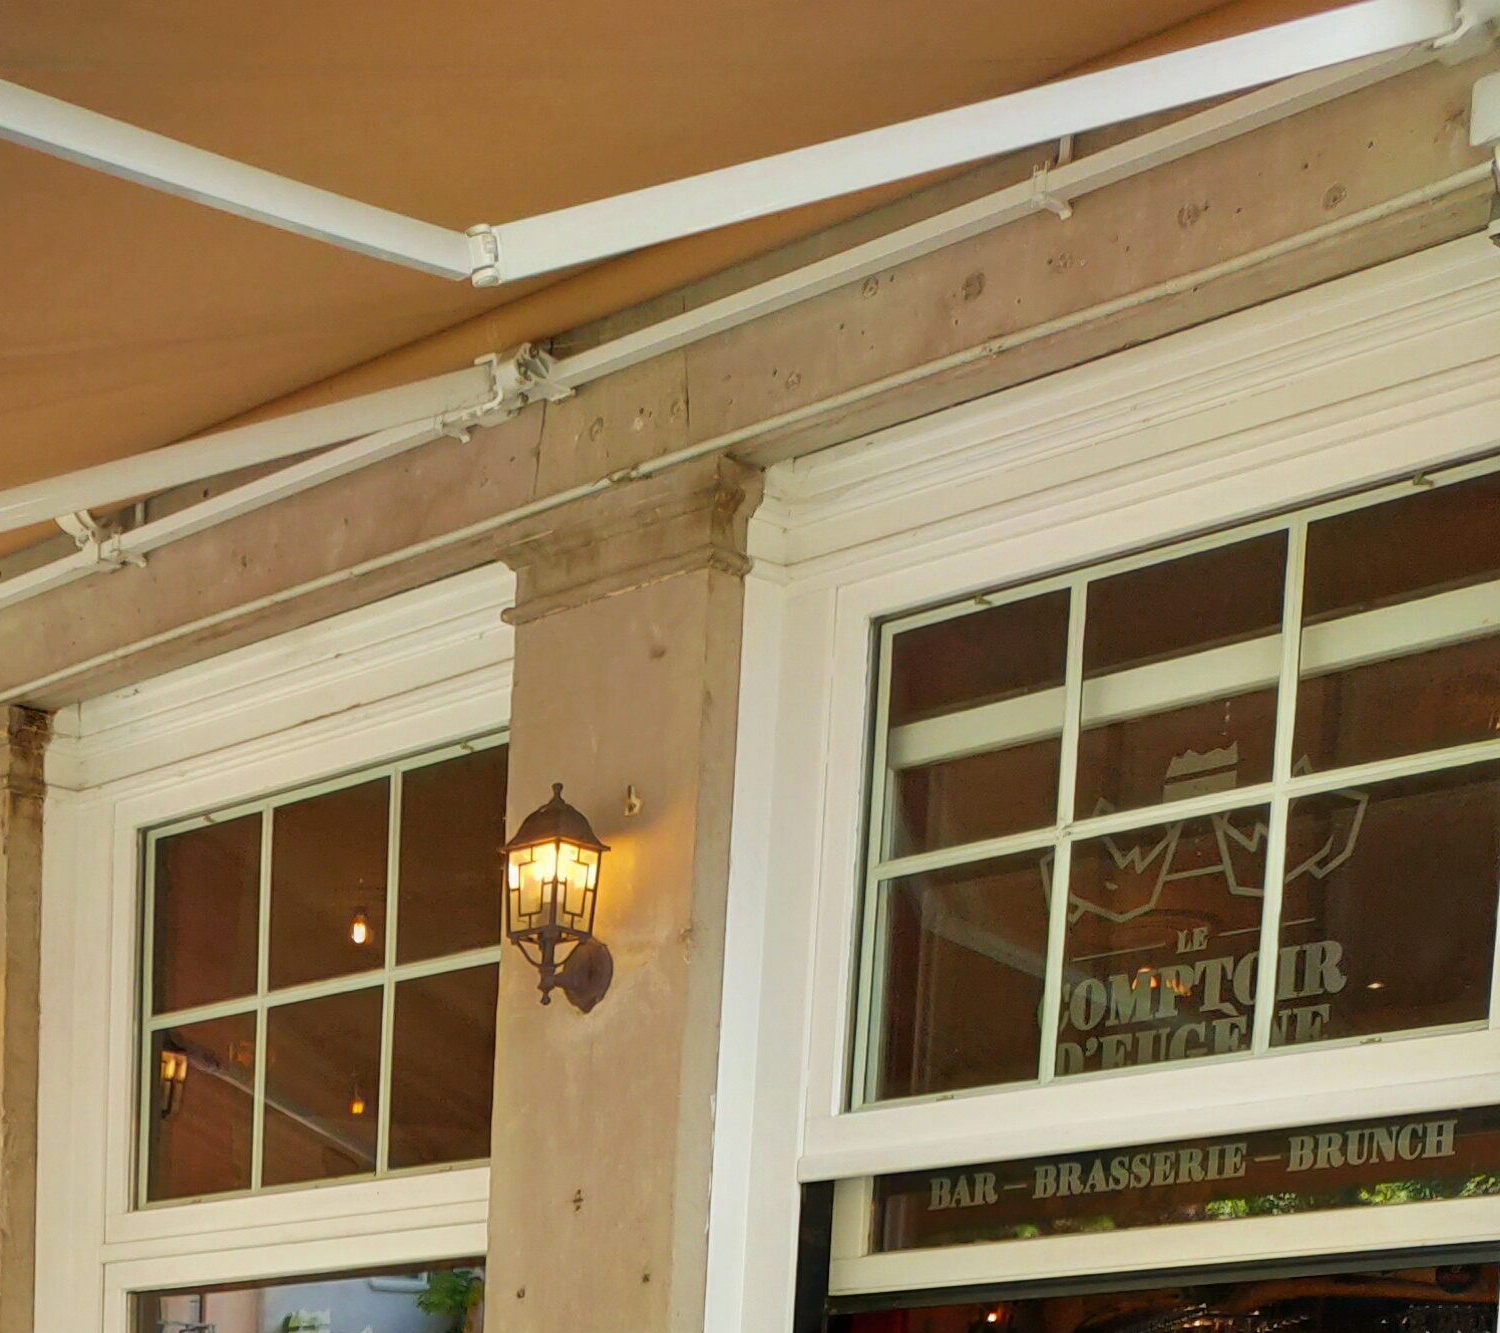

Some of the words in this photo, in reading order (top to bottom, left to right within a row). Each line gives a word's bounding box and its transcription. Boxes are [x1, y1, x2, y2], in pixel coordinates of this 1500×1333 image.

[1176, 926, 1209, 955] LE
[927, 1169, 998, 1212] BAR
[1031, 1142, 1248, 1200] BRASSERIE
[1286, 1119, 1458, 1173] BRUNCH
